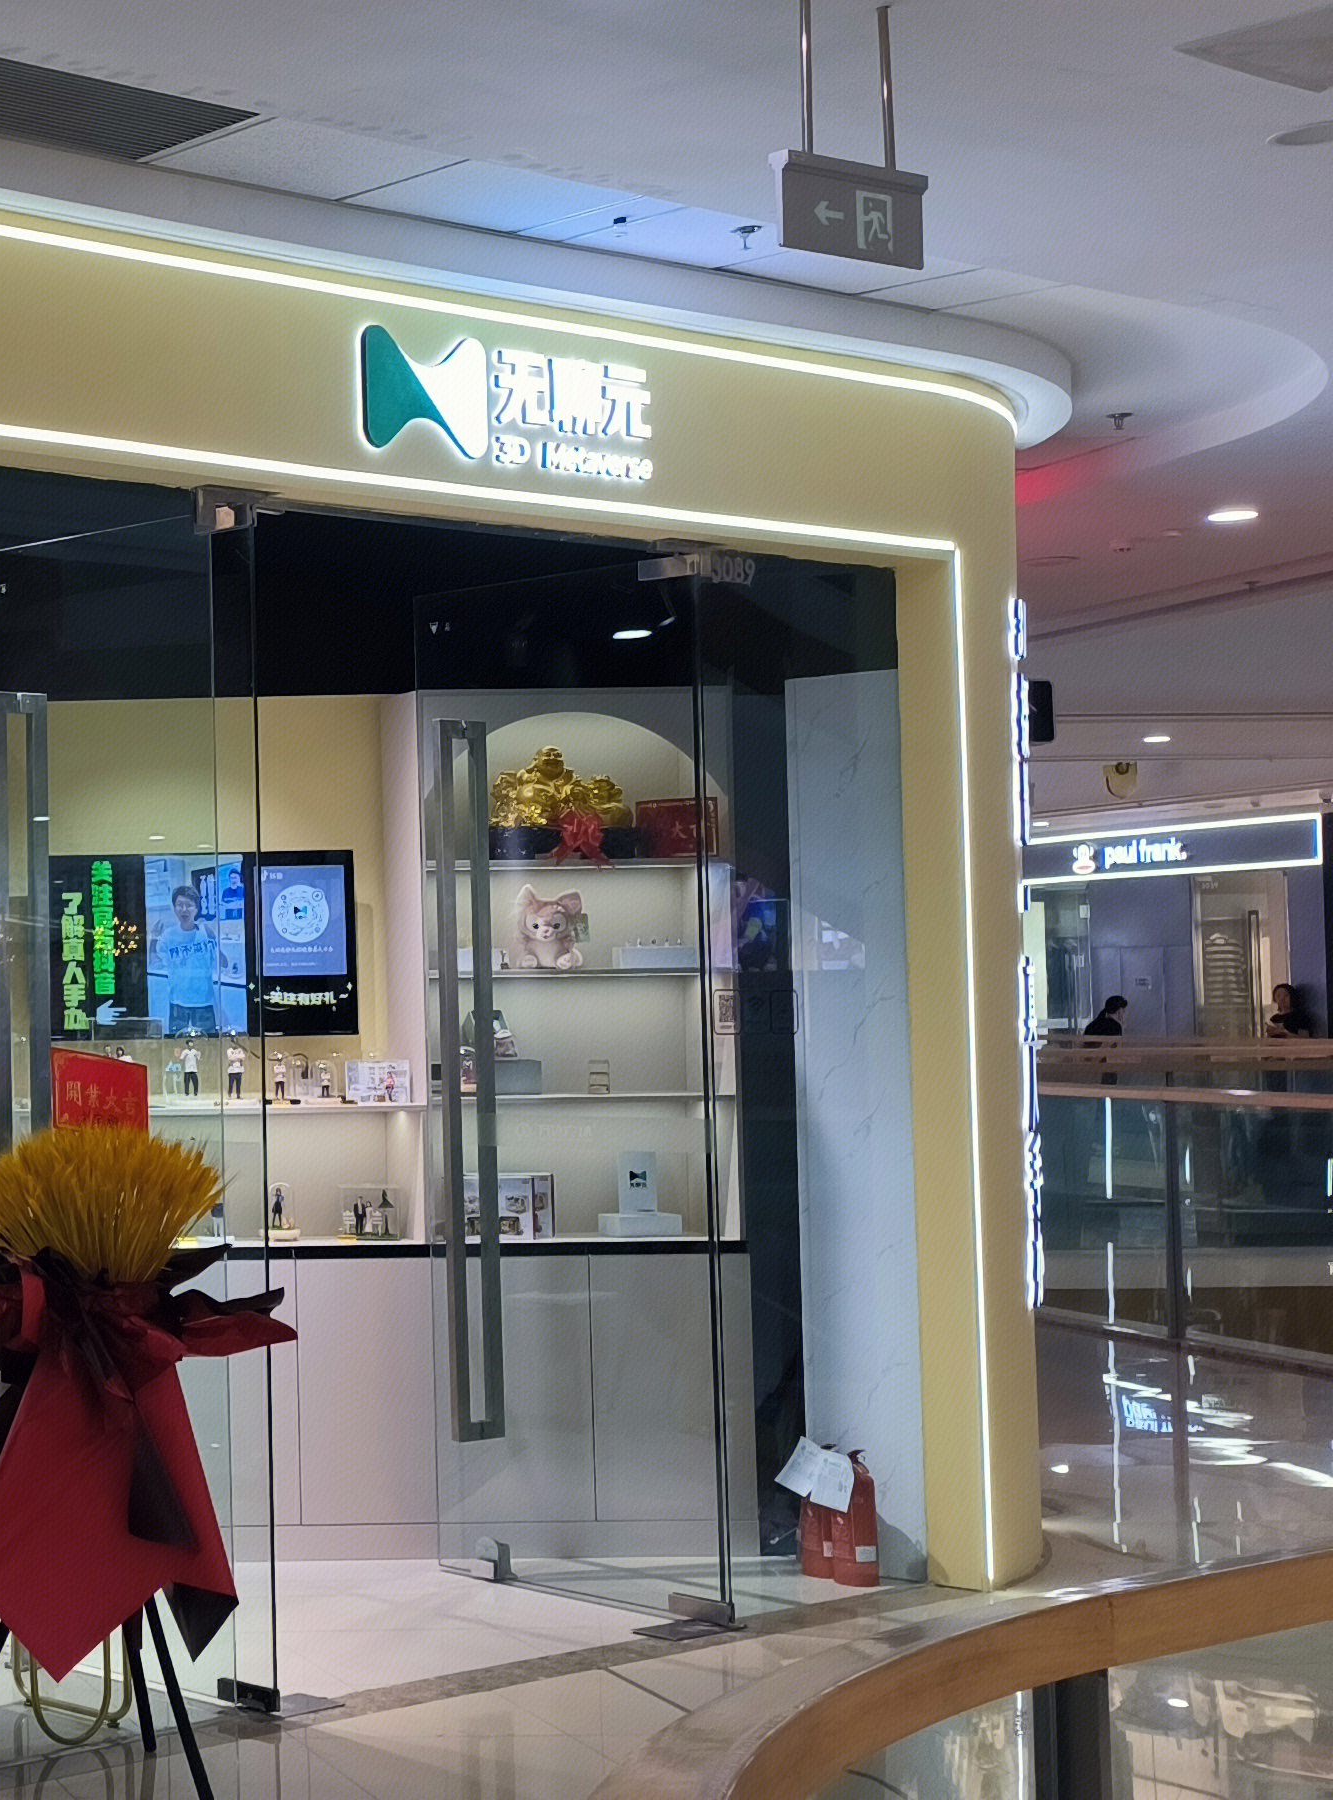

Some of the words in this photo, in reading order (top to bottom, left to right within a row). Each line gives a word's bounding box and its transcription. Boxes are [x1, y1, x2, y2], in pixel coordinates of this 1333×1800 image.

[494, 348, 652, 439] 无聊元
[493, 436, 531, 465] 3D
[541, 440, 654, 481] Metaverse
[1103, 839, 1137, 869] paul
